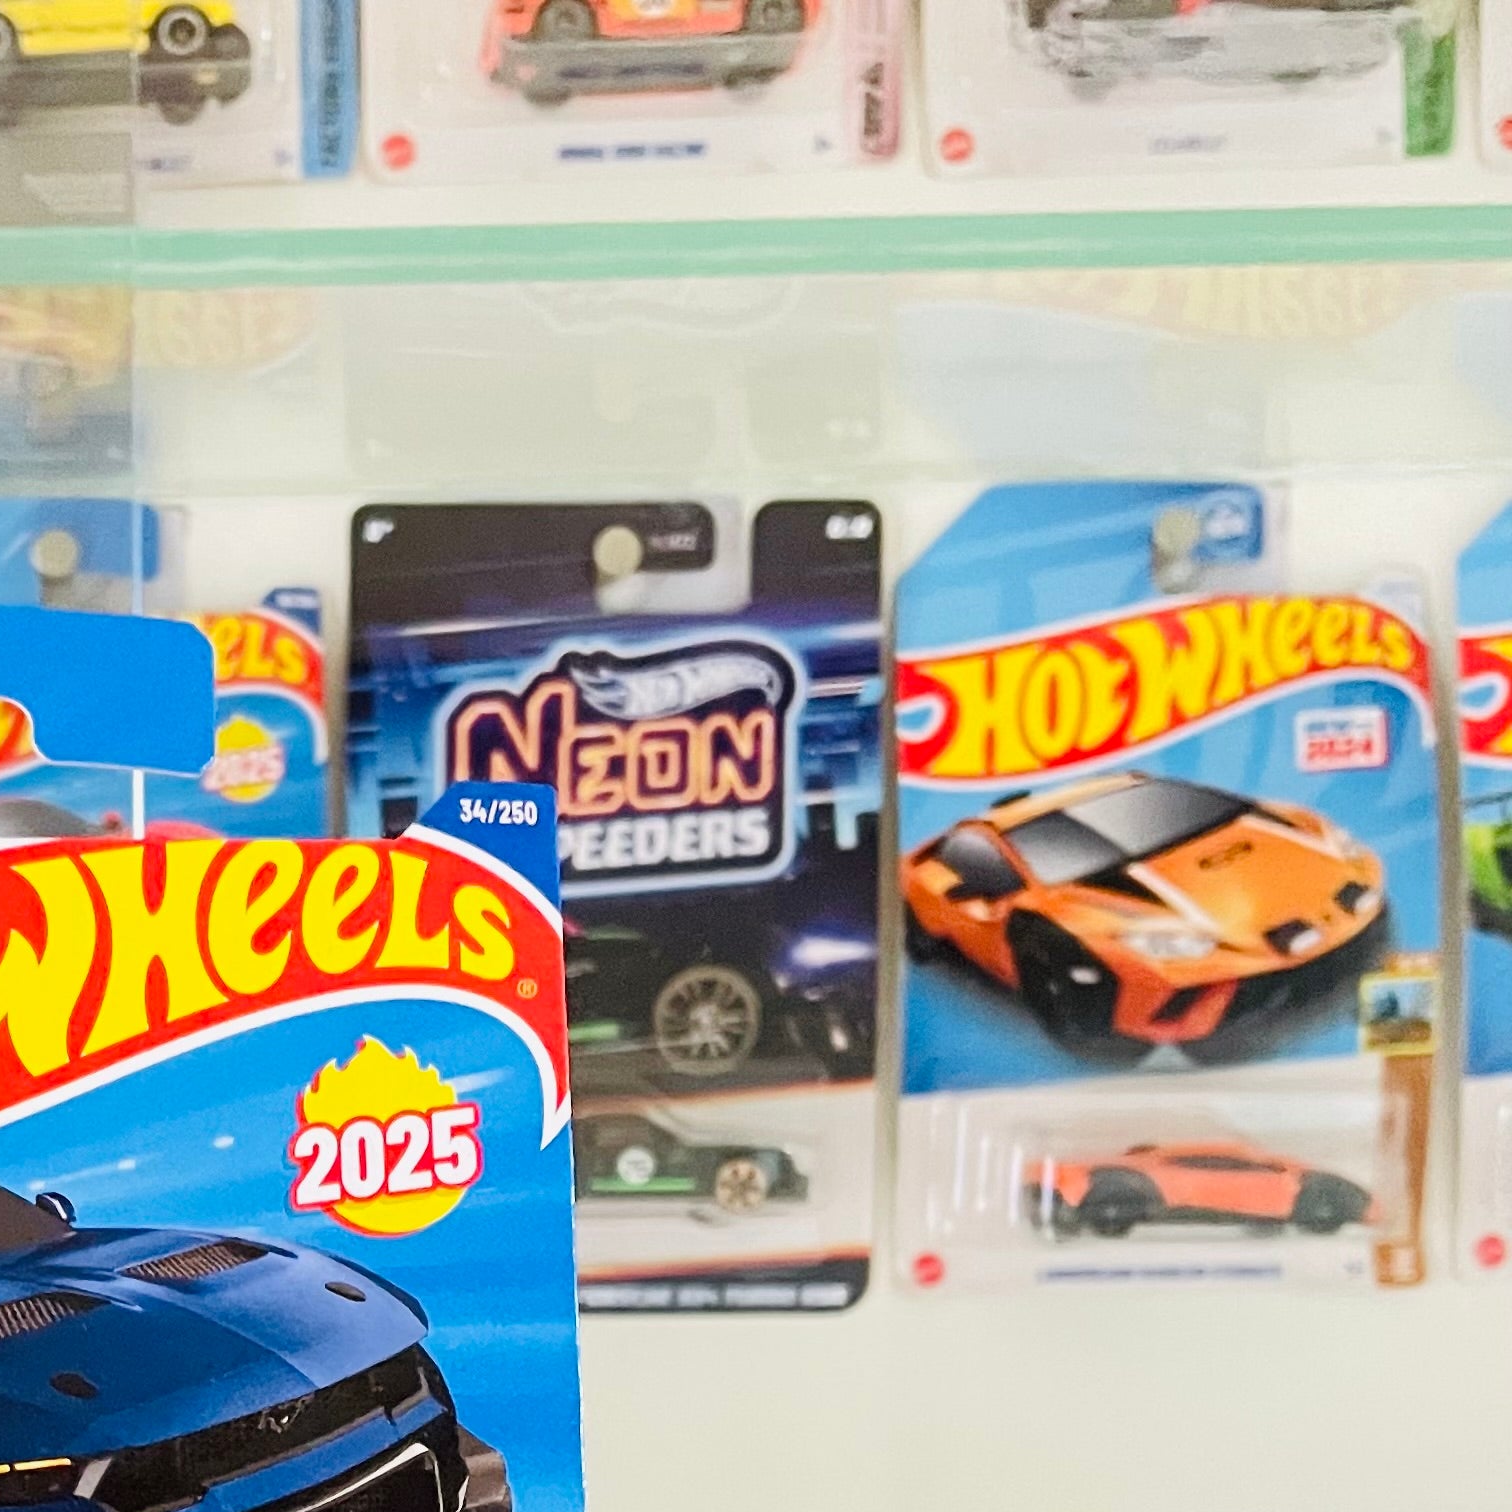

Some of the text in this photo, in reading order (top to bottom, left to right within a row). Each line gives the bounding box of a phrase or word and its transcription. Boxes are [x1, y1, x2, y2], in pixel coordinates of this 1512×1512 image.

[454, 680, 776, 816] NEON
[926, 638, 1129, 777] HOT
[459, 798, 538, 826] 34/250
[294, 1106, 478, 1207] 2025
